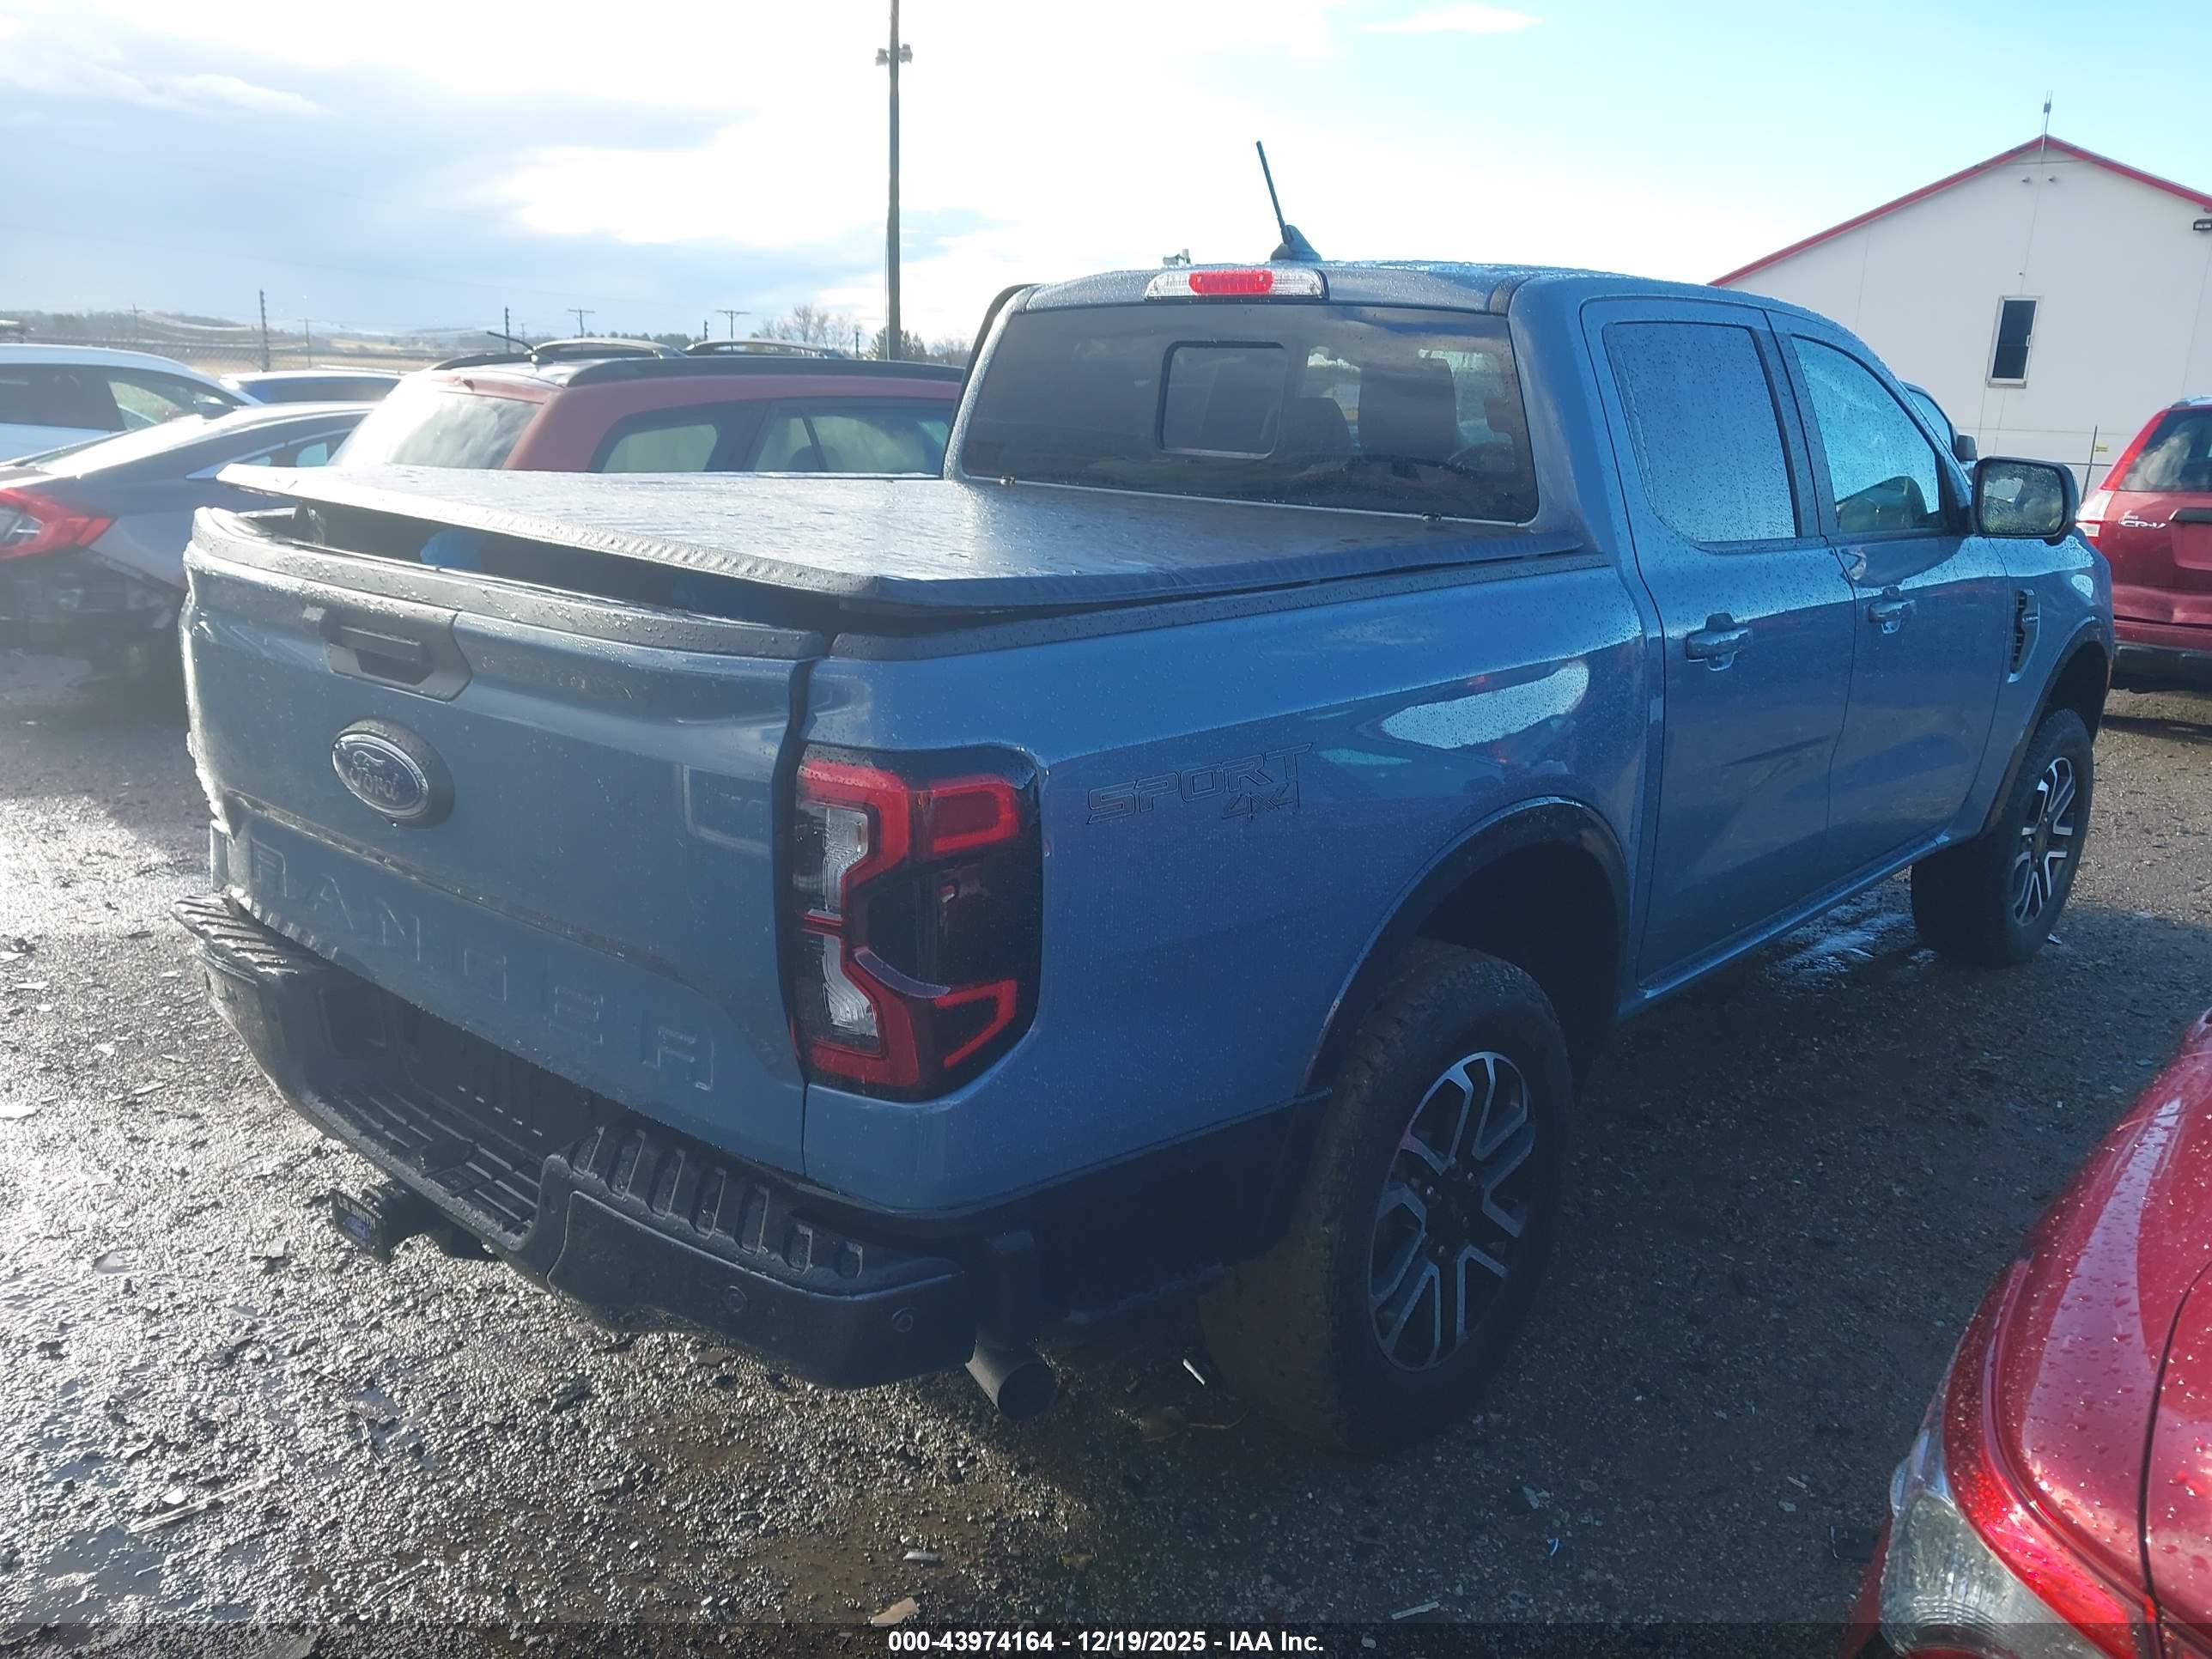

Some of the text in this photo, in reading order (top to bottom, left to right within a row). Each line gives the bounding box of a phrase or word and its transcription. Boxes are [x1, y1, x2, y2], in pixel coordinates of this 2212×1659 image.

[349, 750, 400, 802] Ford
[1086, 741, 1314, 825] SPORT
[251, 836, 716, 1093] RANGER
